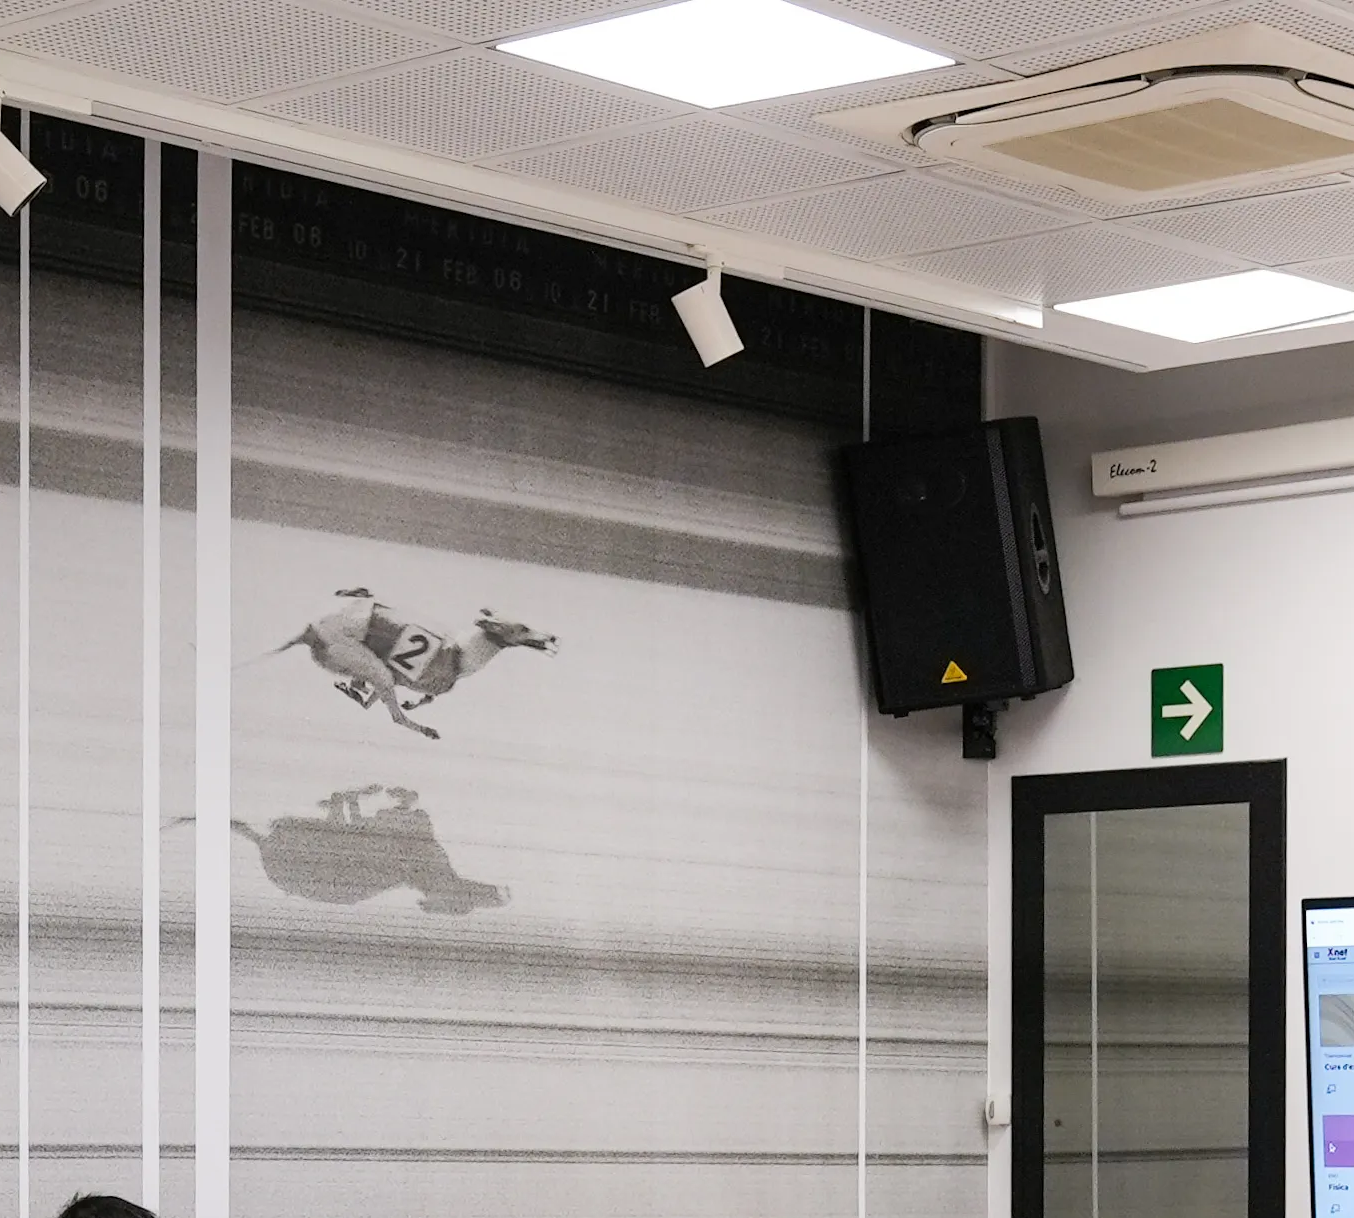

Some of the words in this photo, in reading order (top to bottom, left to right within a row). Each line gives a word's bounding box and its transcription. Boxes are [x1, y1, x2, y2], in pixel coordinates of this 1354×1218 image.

[239, 212, 275, 241] FEB
[443, 257, 478, 285] FEB
[392, 634, 430, 670] 2
[1324, 1063, 1341, 1071] Curs
